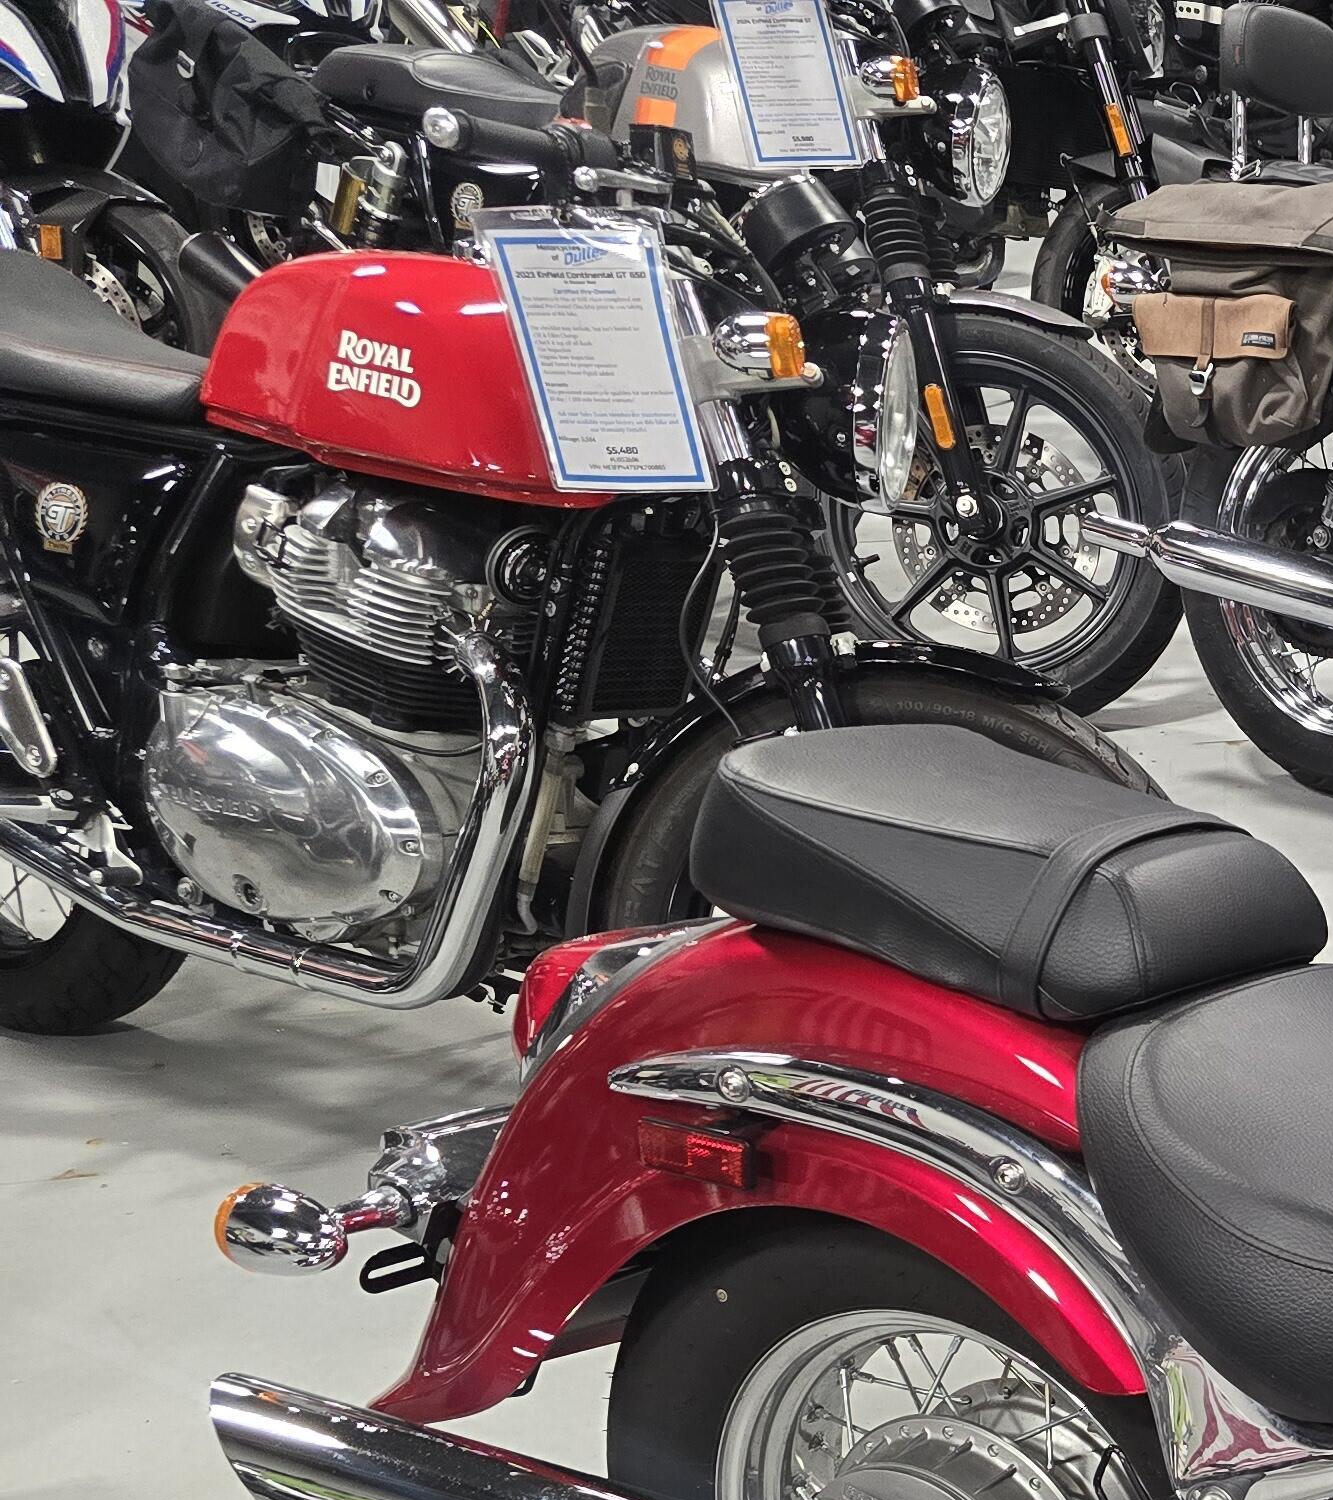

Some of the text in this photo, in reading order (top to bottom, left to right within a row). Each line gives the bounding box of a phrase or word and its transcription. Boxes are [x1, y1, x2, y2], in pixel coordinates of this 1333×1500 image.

[646, 65, 676, 85] ROYAL
[640, 81, 679, 100] ENFIELD
[566, 270, 614, 281] Continental
[337, 329, 413, 374] ROYAL
[327, 361, 421, 408] ENFIELD
